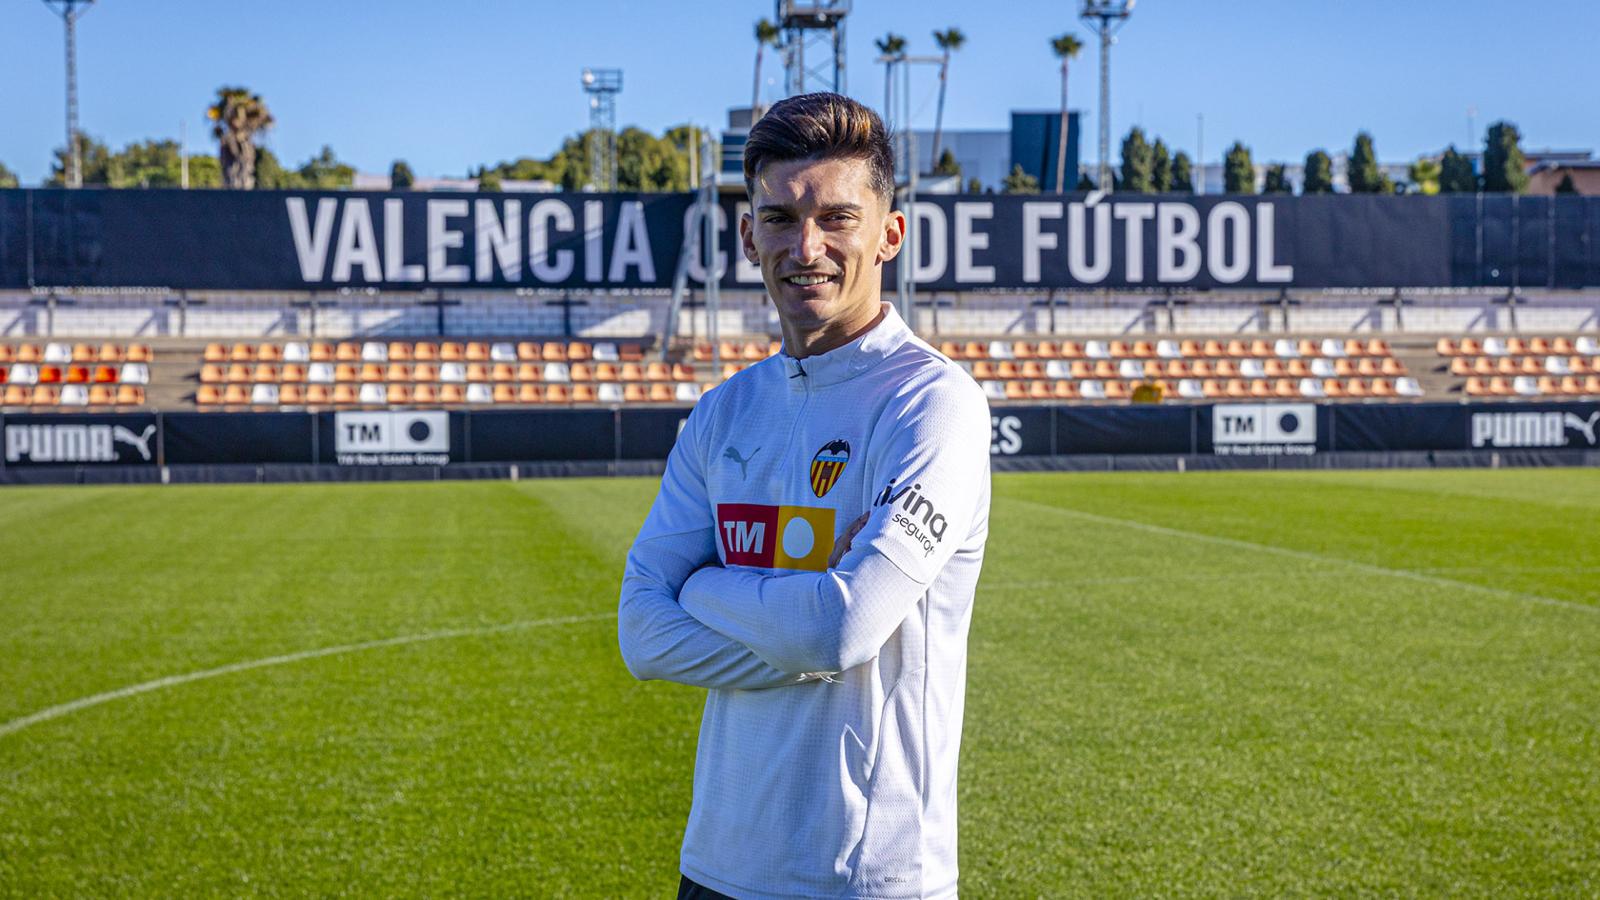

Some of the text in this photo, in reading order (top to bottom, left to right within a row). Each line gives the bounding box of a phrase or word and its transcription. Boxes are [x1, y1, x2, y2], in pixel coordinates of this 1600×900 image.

[286, 197, 656, 282] VALENCIA
[903, 201, 996, 283] DE
[1022, 189, 1294, 284] FÚTBOL
[346, 423, 381, 443] TM
[1222, 415, 1255, 434] TM
[1472, 411, 1564, 447] PUMA
[5, 424, 114, 462] PUMA
[724, 521, 766, 554] TM
